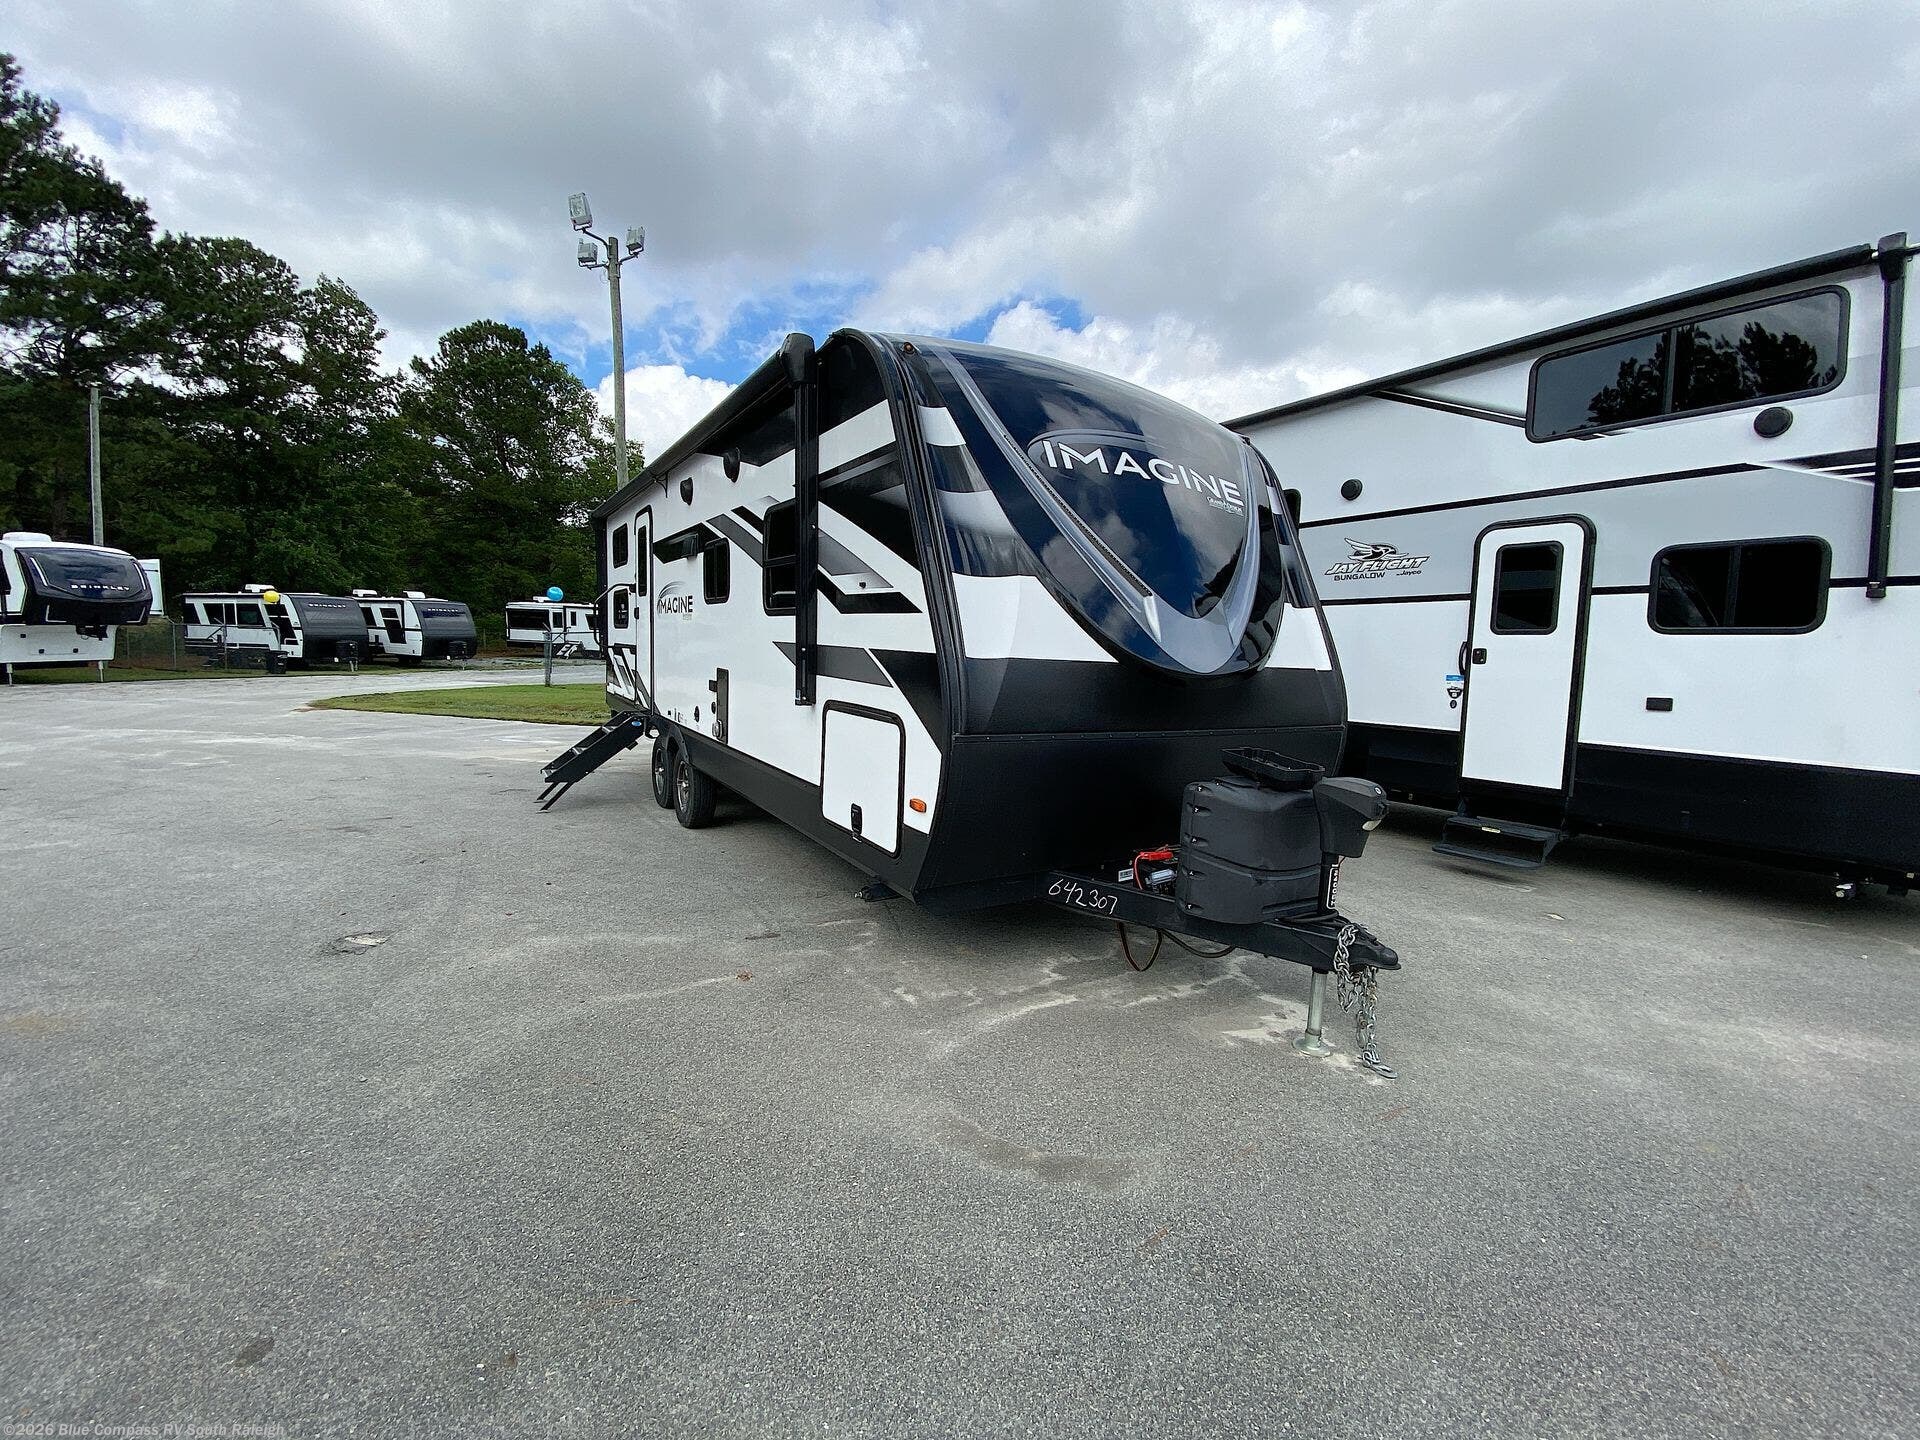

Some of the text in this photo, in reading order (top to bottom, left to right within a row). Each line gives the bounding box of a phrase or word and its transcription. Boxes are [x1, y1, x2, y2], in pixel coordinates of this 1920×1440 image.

[1042, 440, 1244, 506] IMAGINE
[1324, 556, 1430, 576] JAY FLIGHT
[1334, 572, 1385, 581] BUNGALOW
[1048, 879, 1118, 914] 642307
